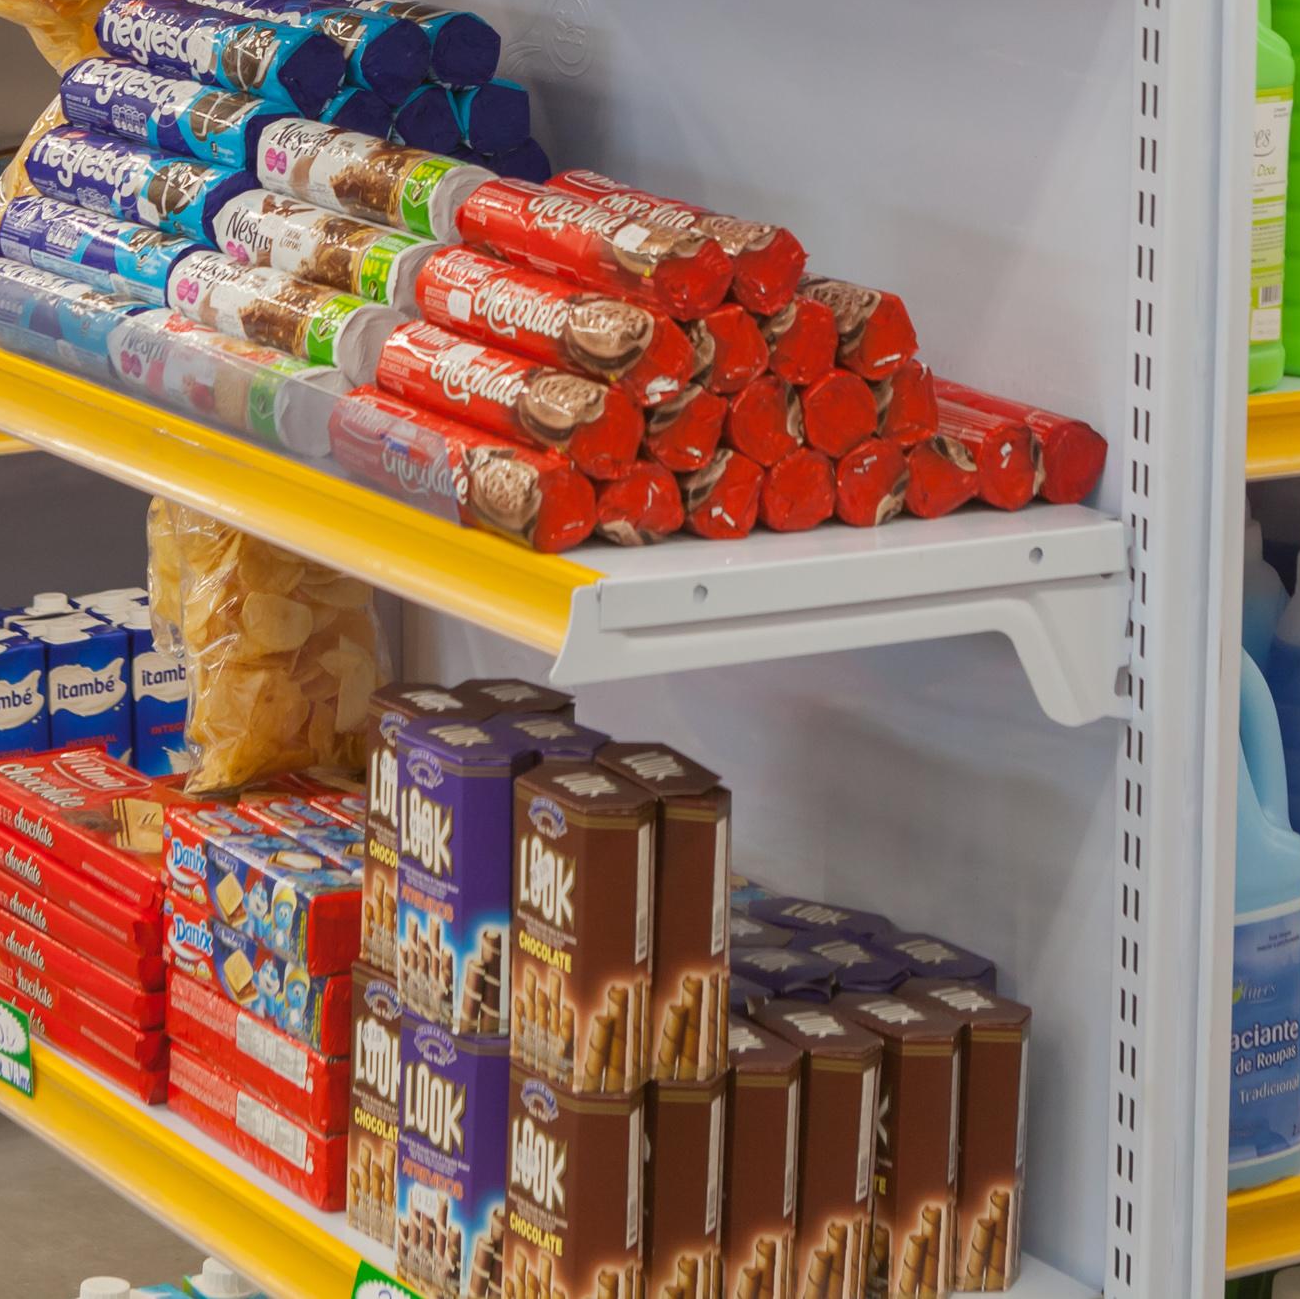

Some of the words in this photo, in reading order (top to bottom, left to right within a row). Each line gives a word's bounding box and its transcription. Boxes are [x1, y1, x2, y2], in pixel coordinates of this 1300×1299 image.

[473, 279, 569, 339] chocolate
[430, 356, 526, 406] chocolate
[56, 673, 117, 701] itambé
[13, 806, 54, 848] chocolate
[401, 787, 453, 874] LOOK
[5, 843, 42, 886] chocolate
[172, 840, 207, 877] Danix
[519, 834, 576, 928] LOOK
[5, 929, 46, 972] chocolate
[173, 914, 213, 952] Danix
[518, 929, 572, 973] CHOCOLATE
[1236, 1057, 1252, 1076] de
[1257, 1045, 1297, 1069] Roupas
[404, 1059, 467, 1152] LOOK
[1239, 1073, 1300, 1105] Tradicional
[512, 1116, 569, 1209] LOOK
[509, 1210, 563, 1257] CHOCOLATE
